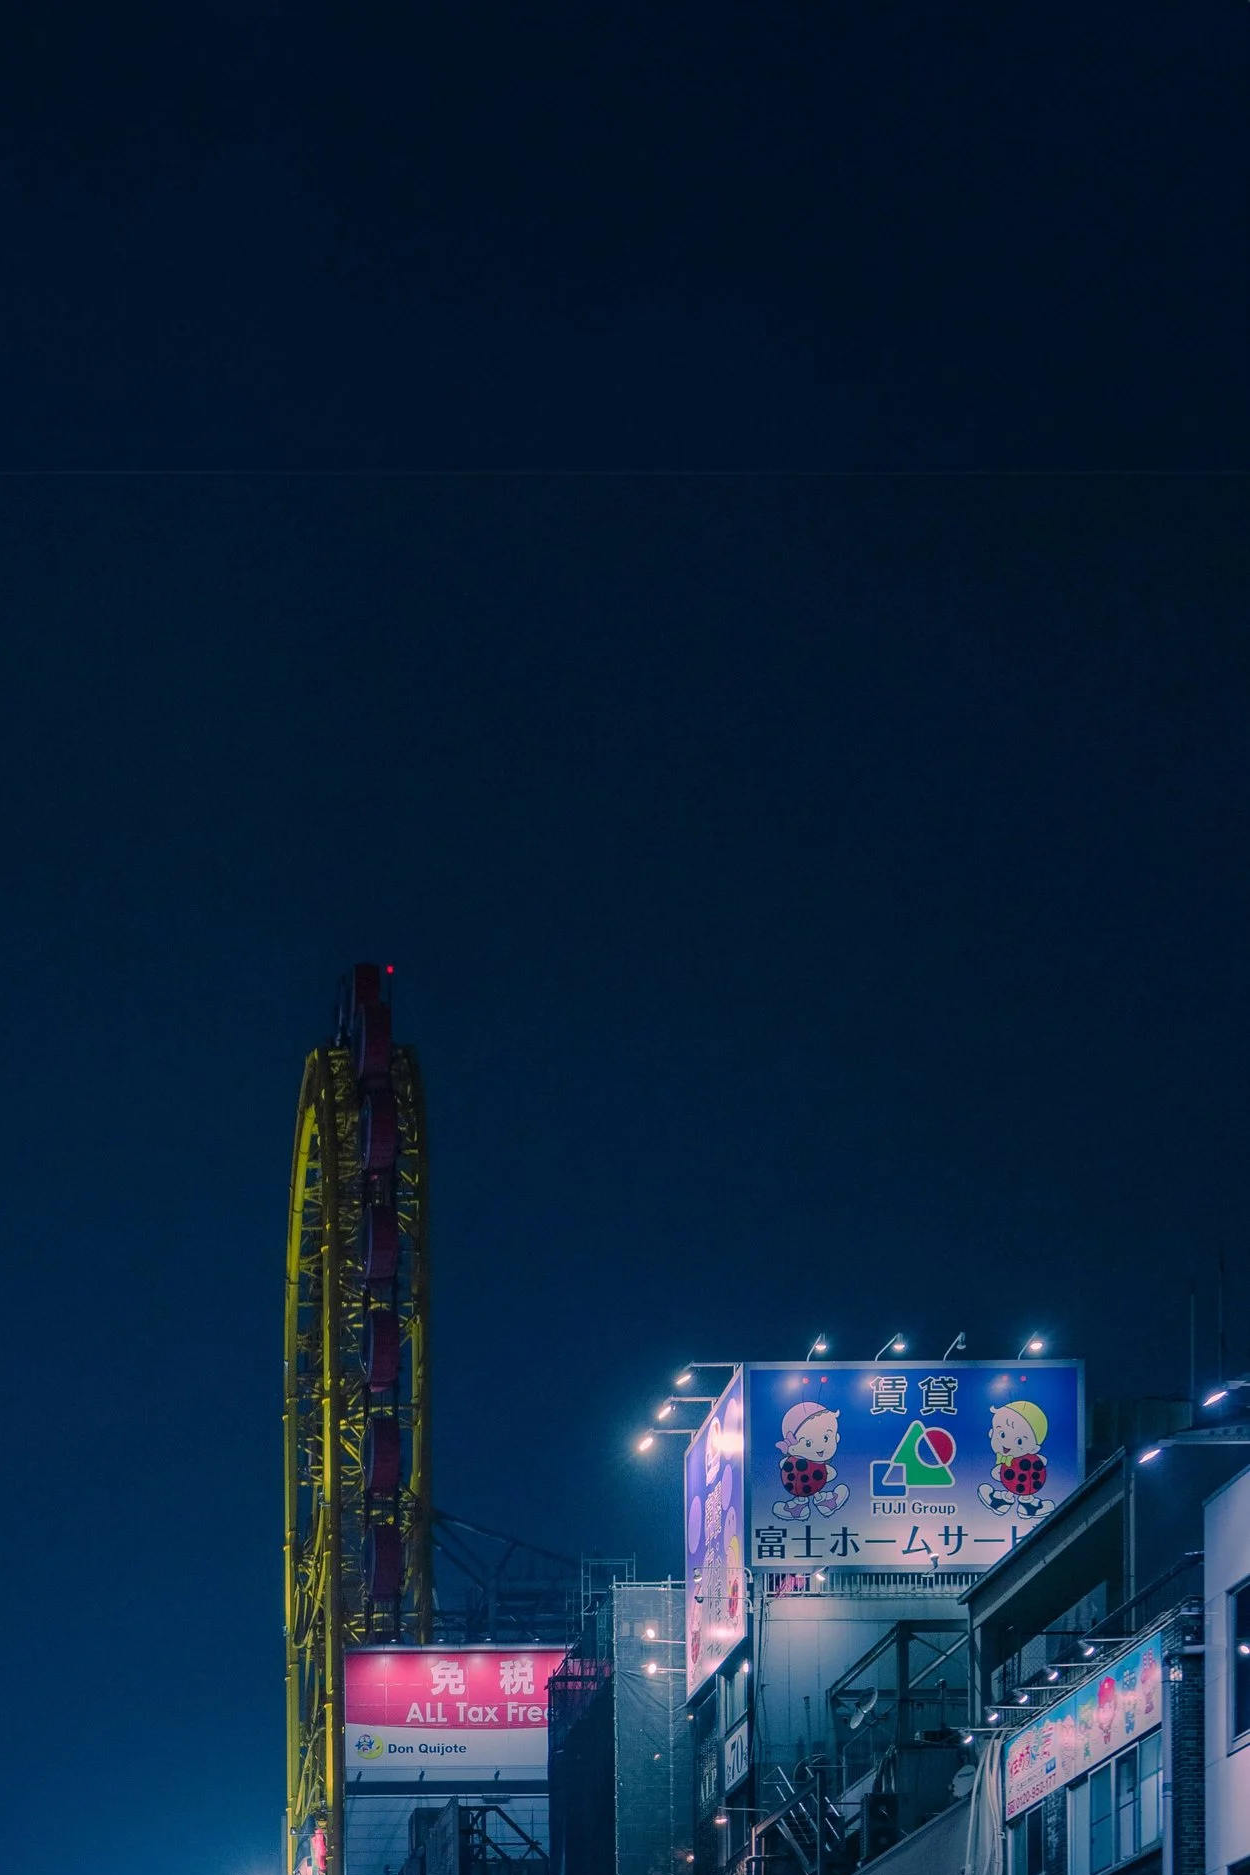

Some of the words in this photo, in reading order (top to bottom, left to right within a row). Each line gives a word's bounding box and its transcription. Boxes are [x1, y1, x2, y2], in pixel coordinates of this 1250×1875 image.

[869, 1375, 959, 1416] 賃貸
[871, 1501, 907, 1515] FUJI
[911, 1501, 956, 1517] Group
[430, 1659, 535, 1696] 免税
[406, 1702, 448, 1723] ALL
[456, 1702, 499, 1723] Tax
[388, 1742, 414, 1755] Don
[418, 1741, 467, 1756] Quijote
